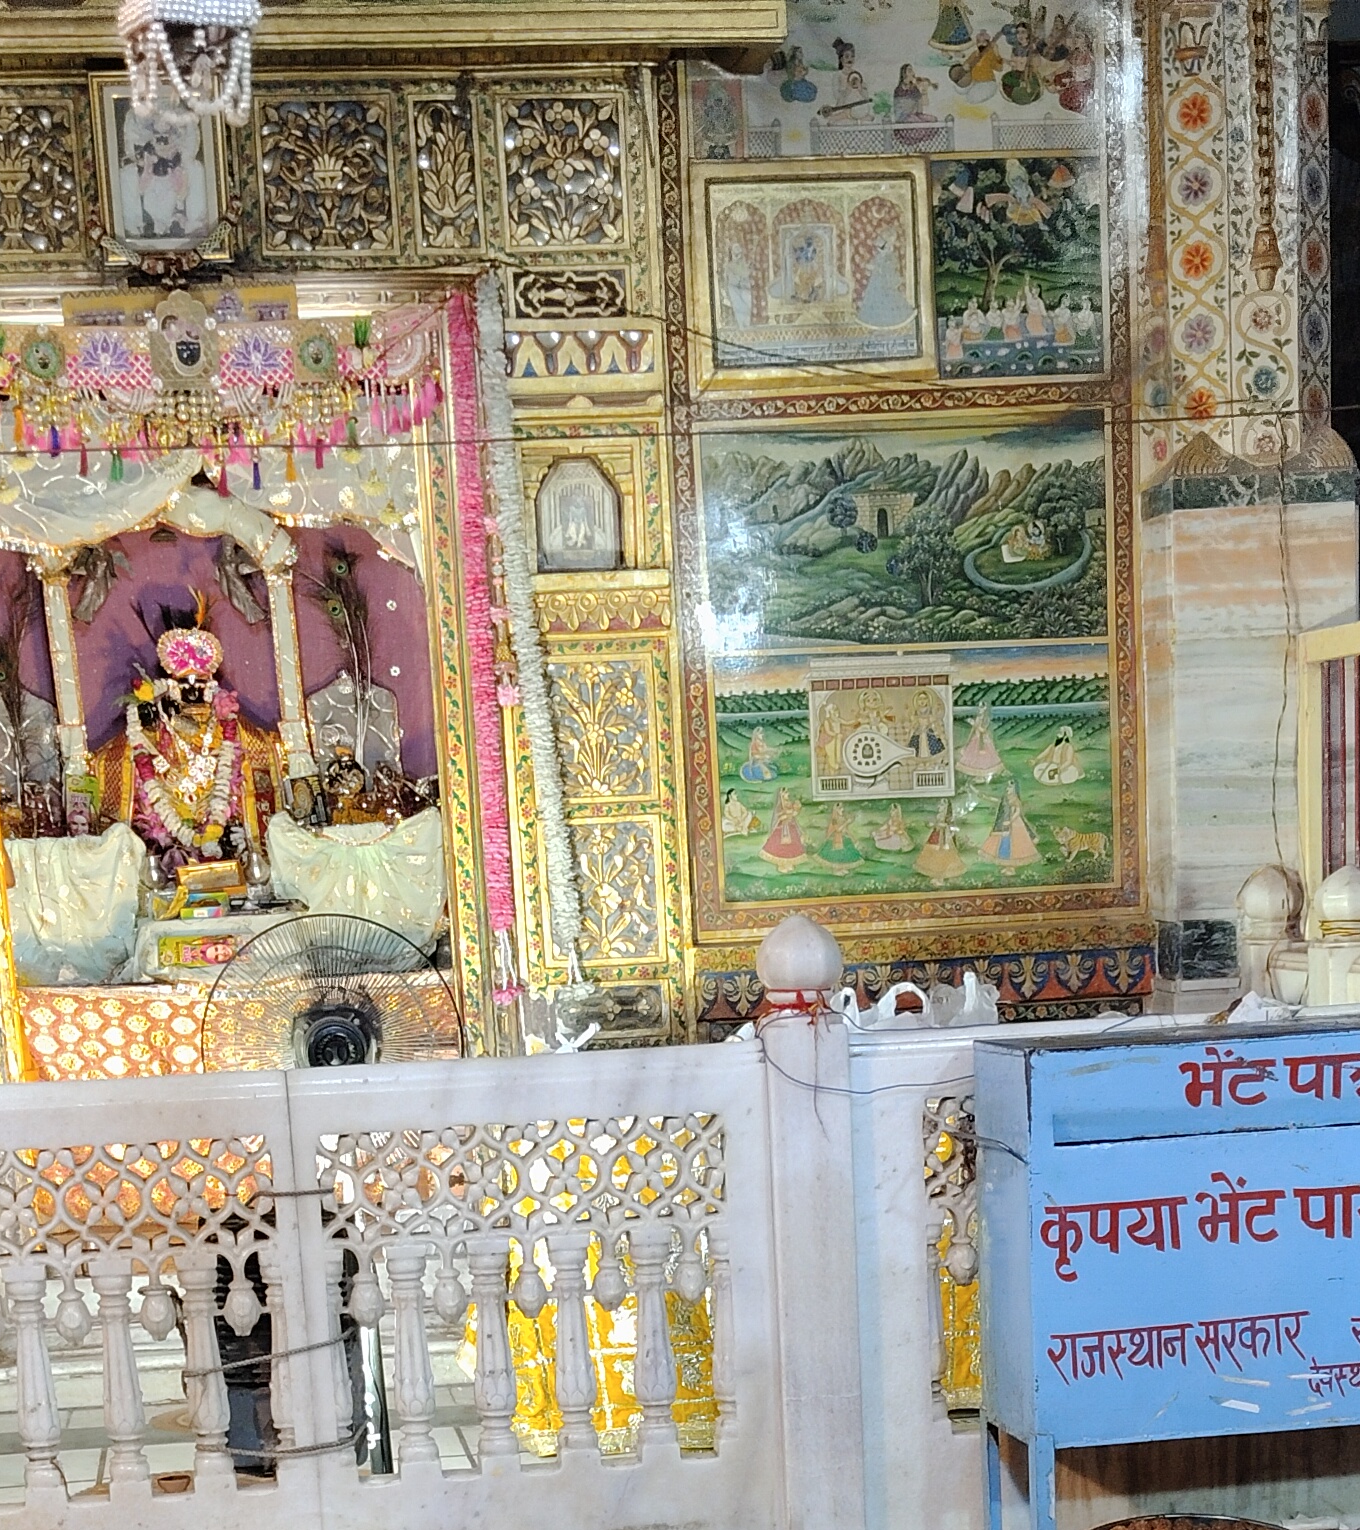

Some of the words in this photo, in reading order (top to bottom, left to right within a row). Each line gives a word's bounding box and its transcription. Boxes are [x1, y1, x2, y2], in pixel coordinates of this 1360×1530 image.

[1180, 1047, 1277, 1107] भेंट
[1041, 1196, 1188, 1282] कृपया
[1195, 1172, 1286, 1243] भेंट
[1048, 1323, 1193, 1385] राजस्थान
[1196, 1311, 1310, 1374] सरकार
